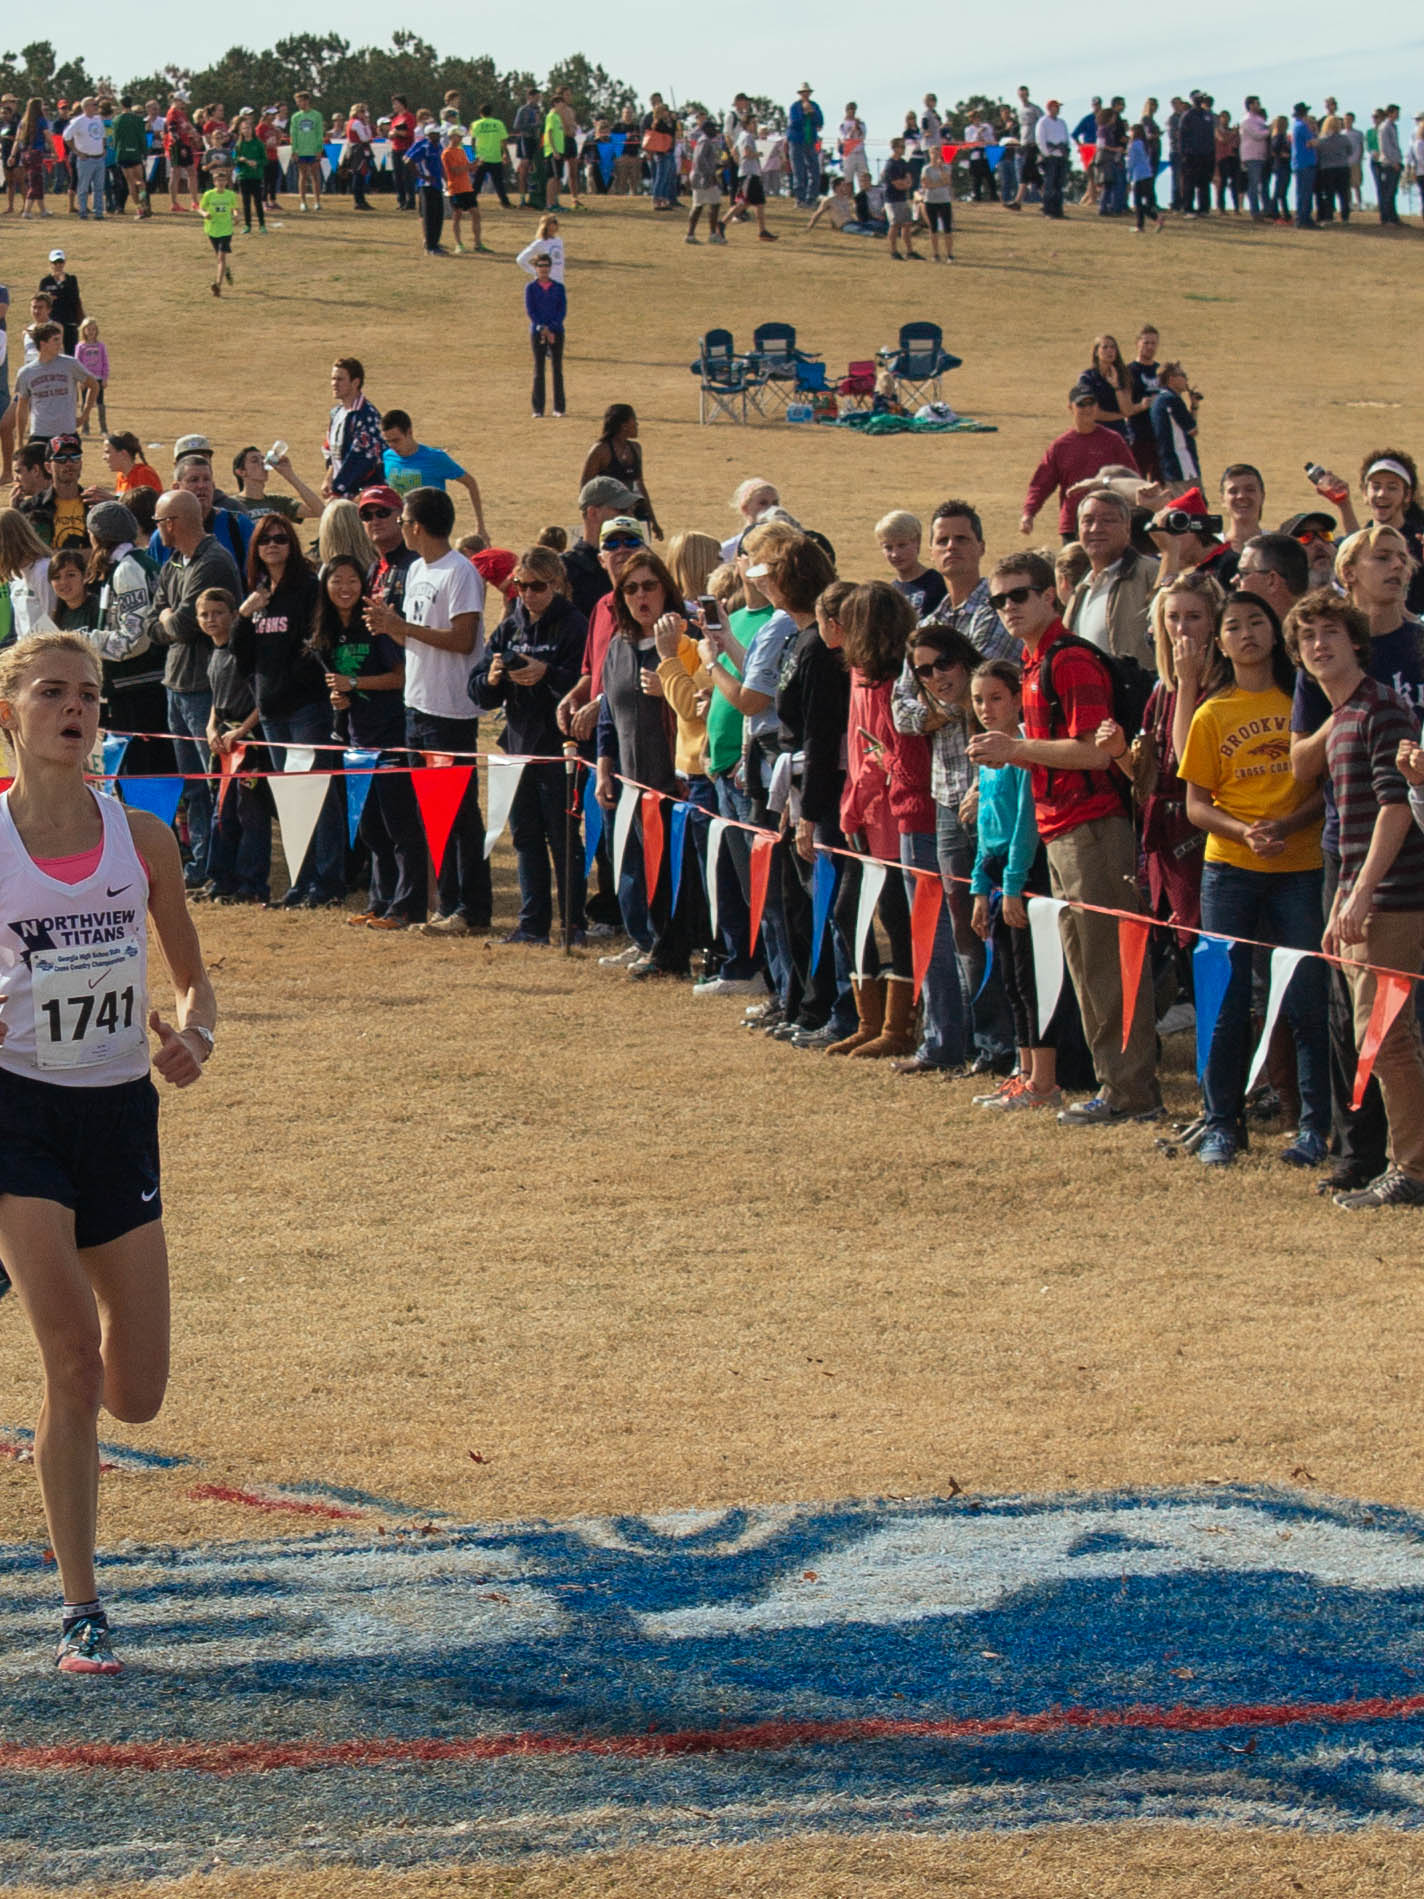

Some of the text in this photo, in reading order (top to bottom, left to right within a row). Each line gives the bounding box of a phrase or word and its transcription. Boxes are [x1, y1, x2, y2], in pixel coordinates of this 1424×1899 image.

[1220, 716, 1291, 758] BROOKV
[1235, 761, 1292, 778] CROSS COU
[20, 909, 136, 938] NORTHVIEW
[61, 926, 125, 946] TITANS
[57, 954, 79, 963] Georgia
[79, 952, 92, 961] High
[70, 962, 91, 971] Country
[41, 985, 135, 1043] 1741
